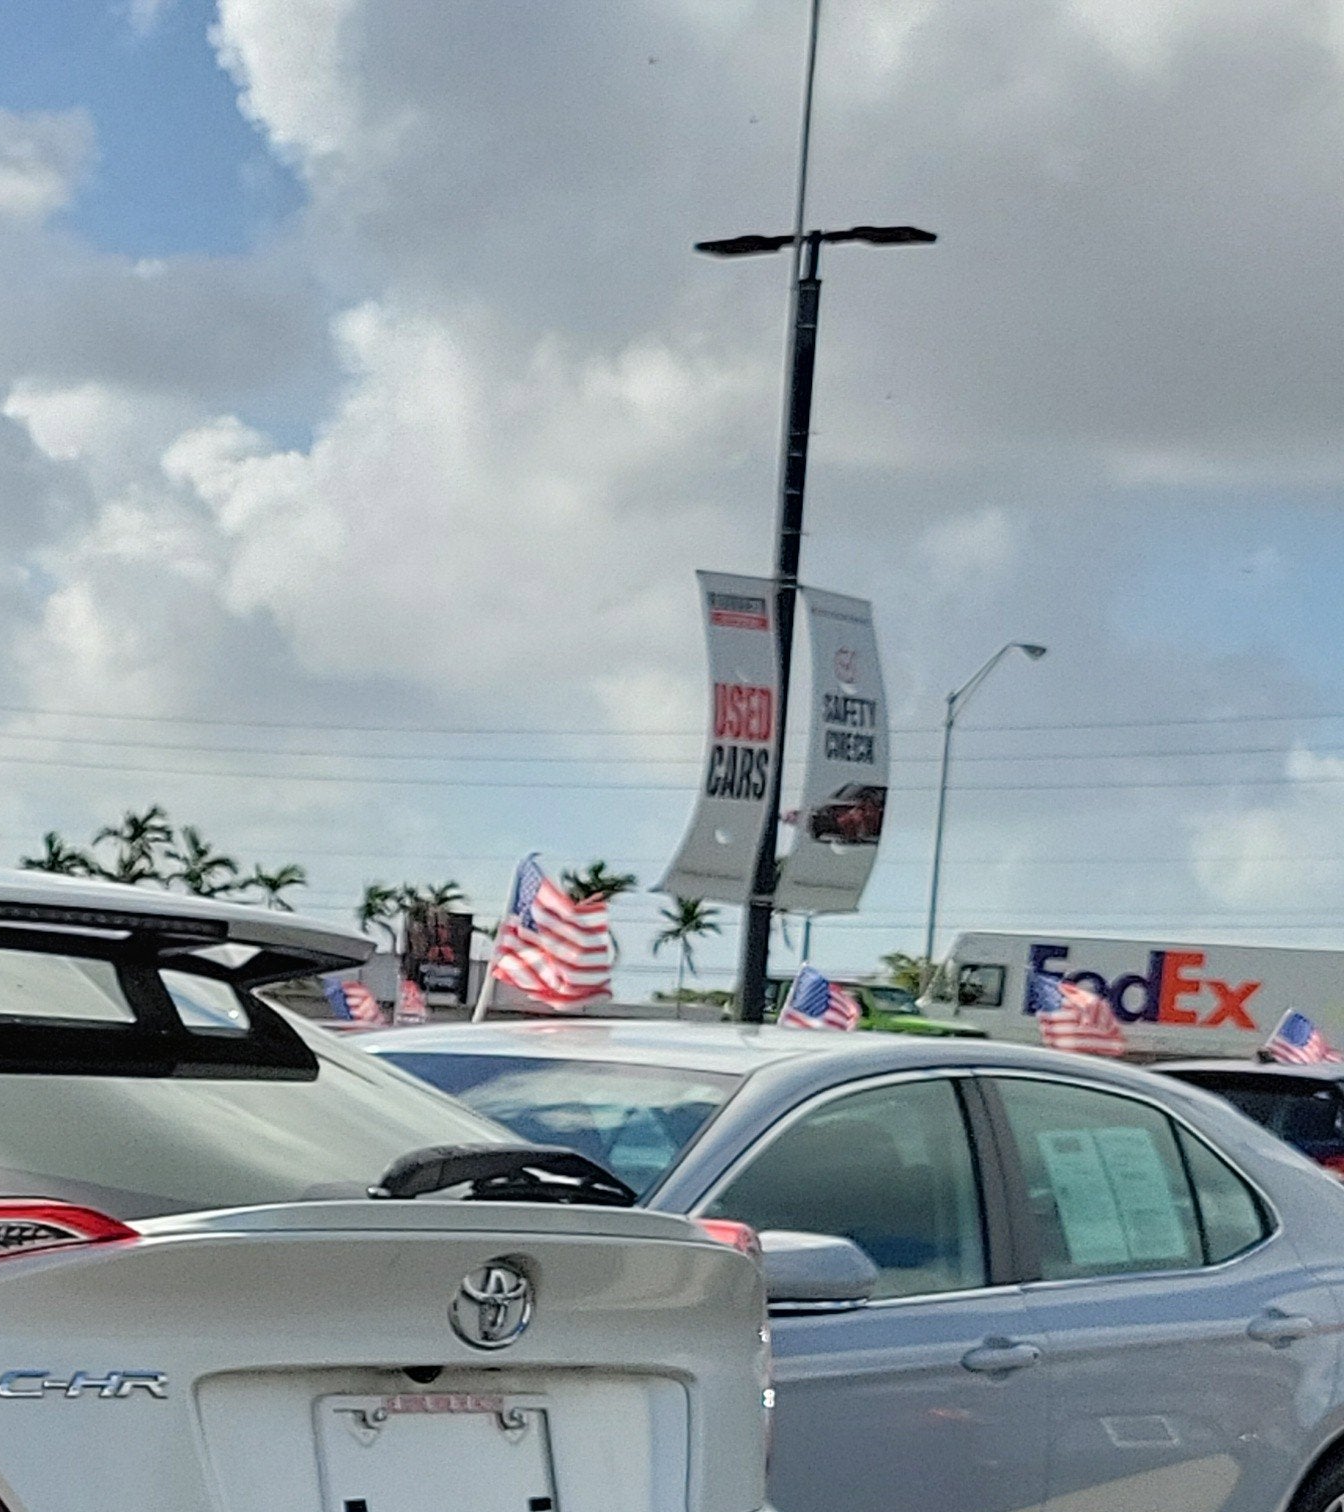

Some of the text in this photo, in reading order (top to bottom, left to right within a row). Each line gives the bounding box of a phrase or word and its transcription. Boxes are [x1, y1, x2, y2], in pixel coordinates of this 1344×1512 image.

[713, 681, 772, 741] USED
[824, 694, 876, 728] SAFETY
[706, 745, 769, 800] CARS
